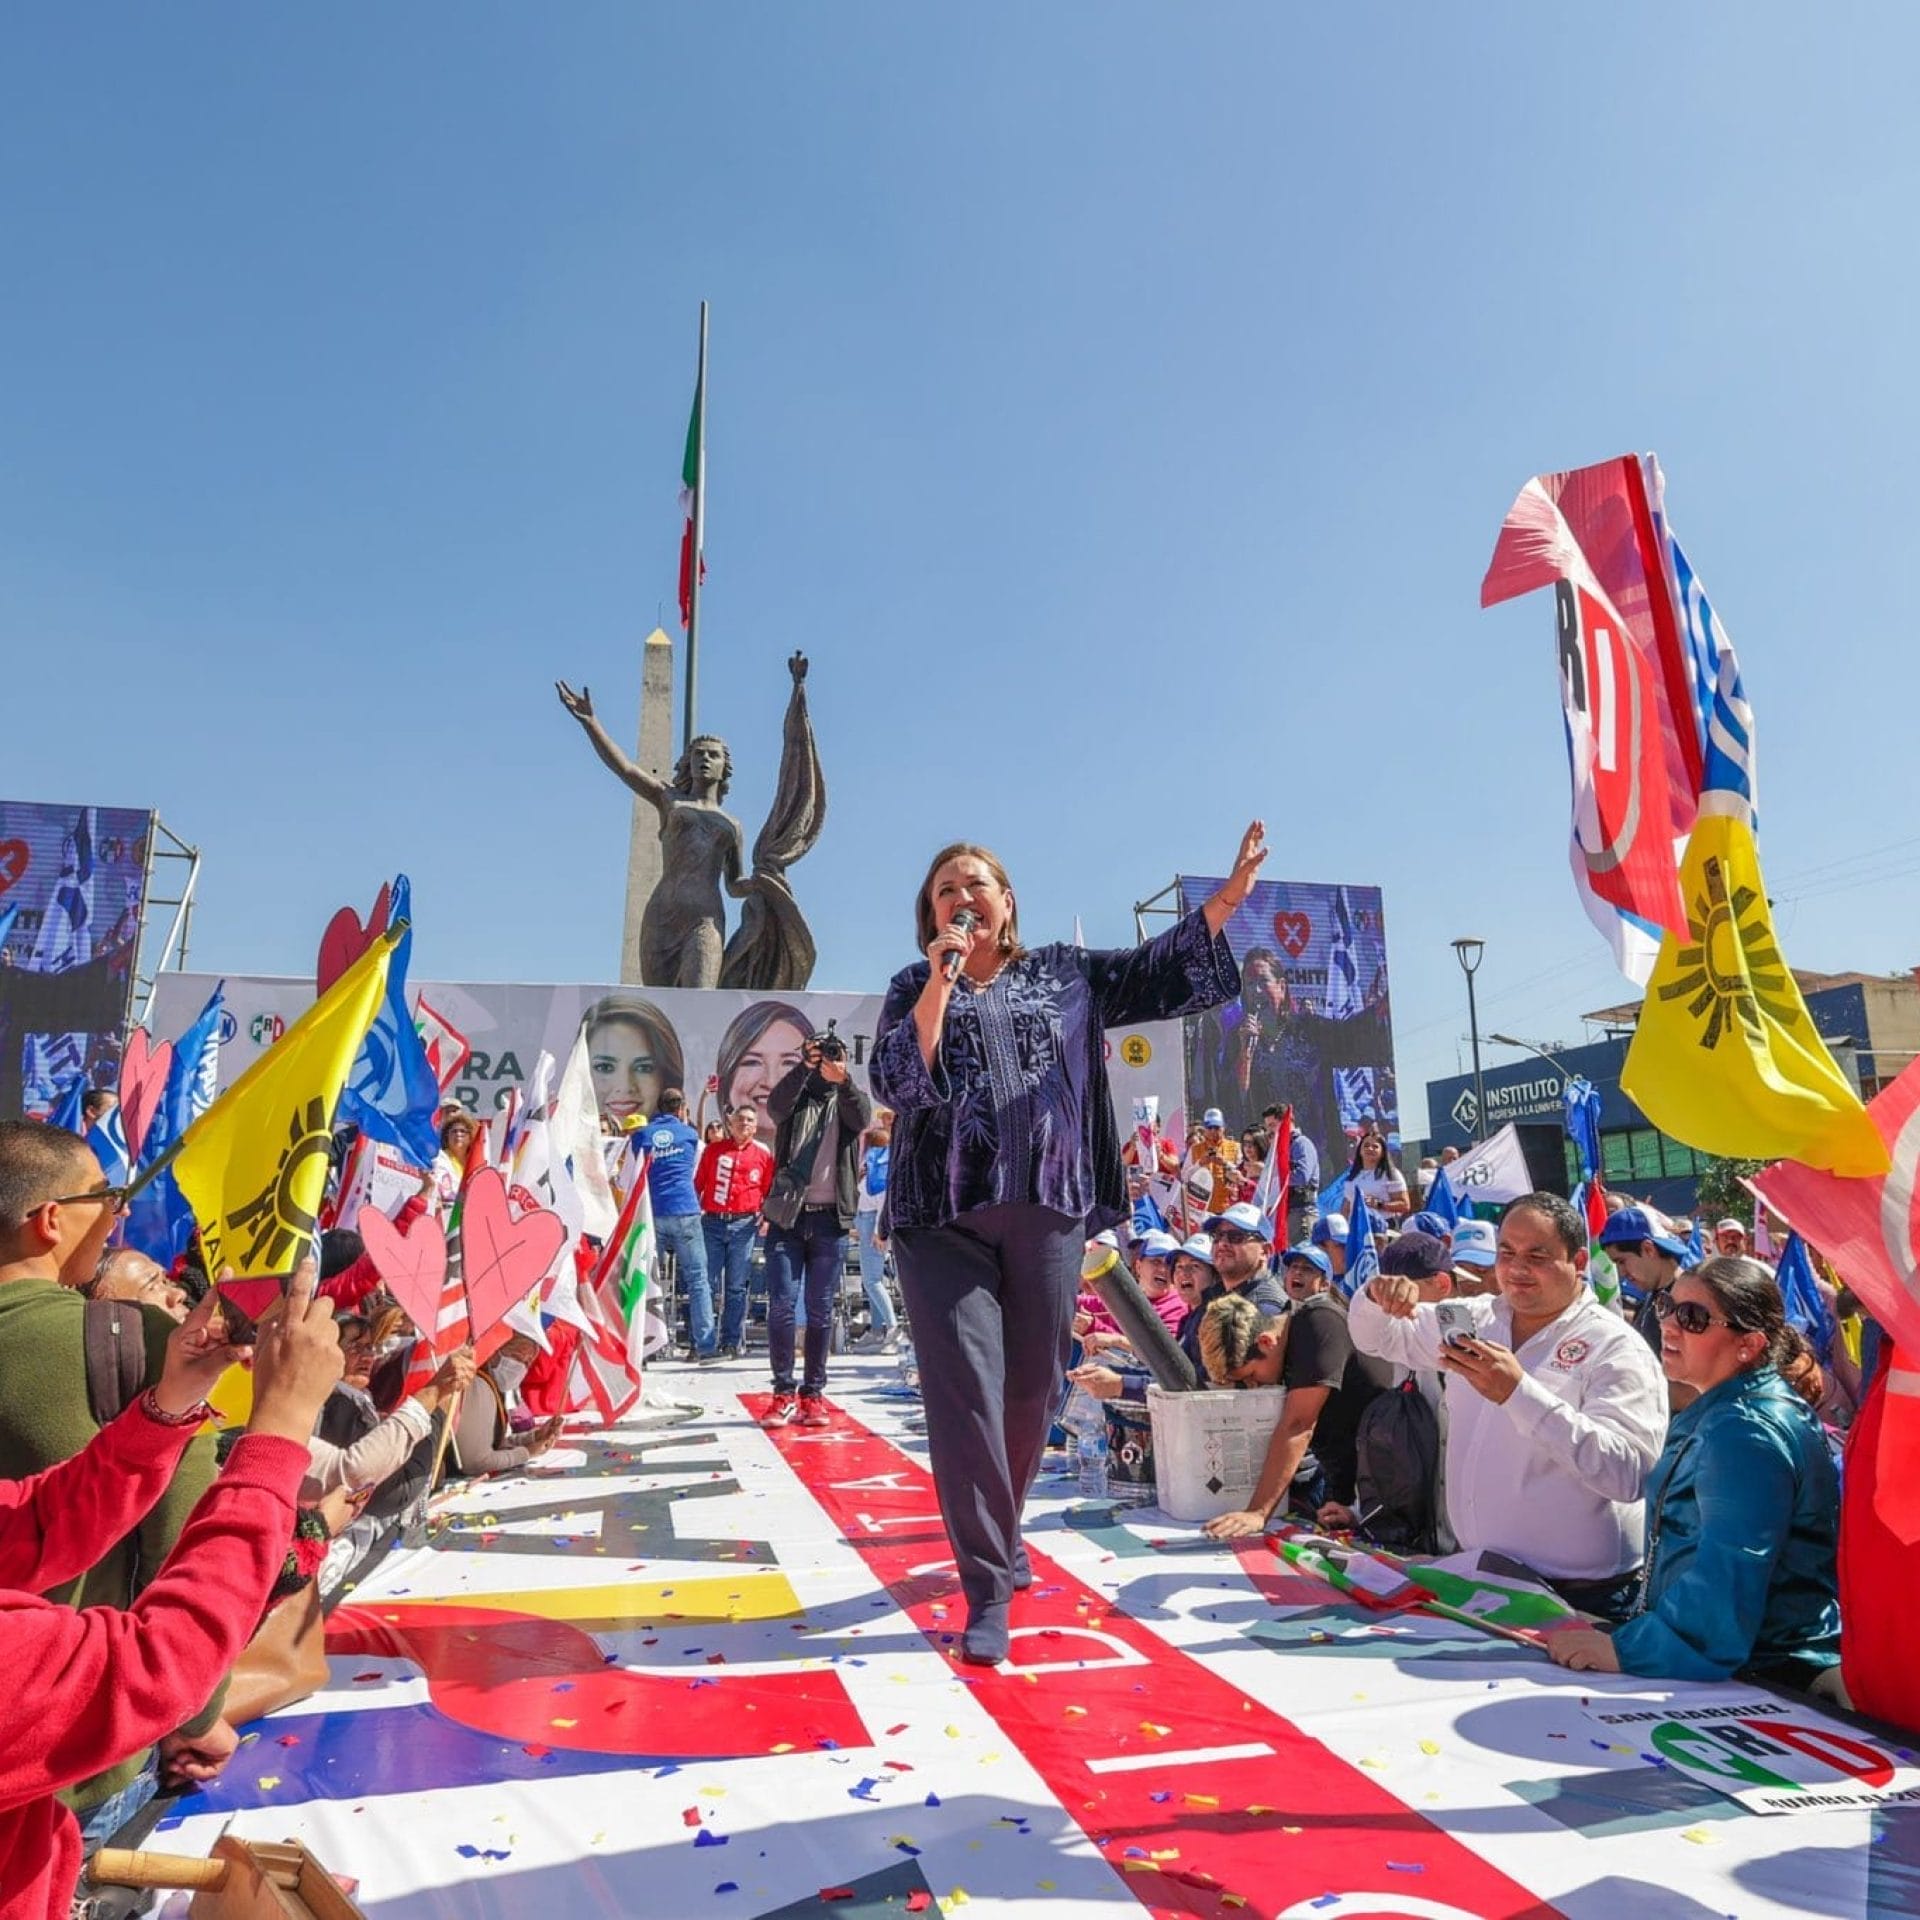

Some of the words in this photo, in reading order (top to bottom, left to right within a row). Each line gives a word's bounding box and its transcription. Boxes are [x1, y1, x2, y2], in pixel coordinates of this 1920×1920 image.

[1486, 1077, 1559, 1108] INSTITUTO
[1459, 1102, 1477, 1121] AS
[1599, 1711, 1659, 1724] SAN
[1663, 1702, 1792, 1722] GABRIEL
[1763, 1796, 1855, 1809] RUMBO
